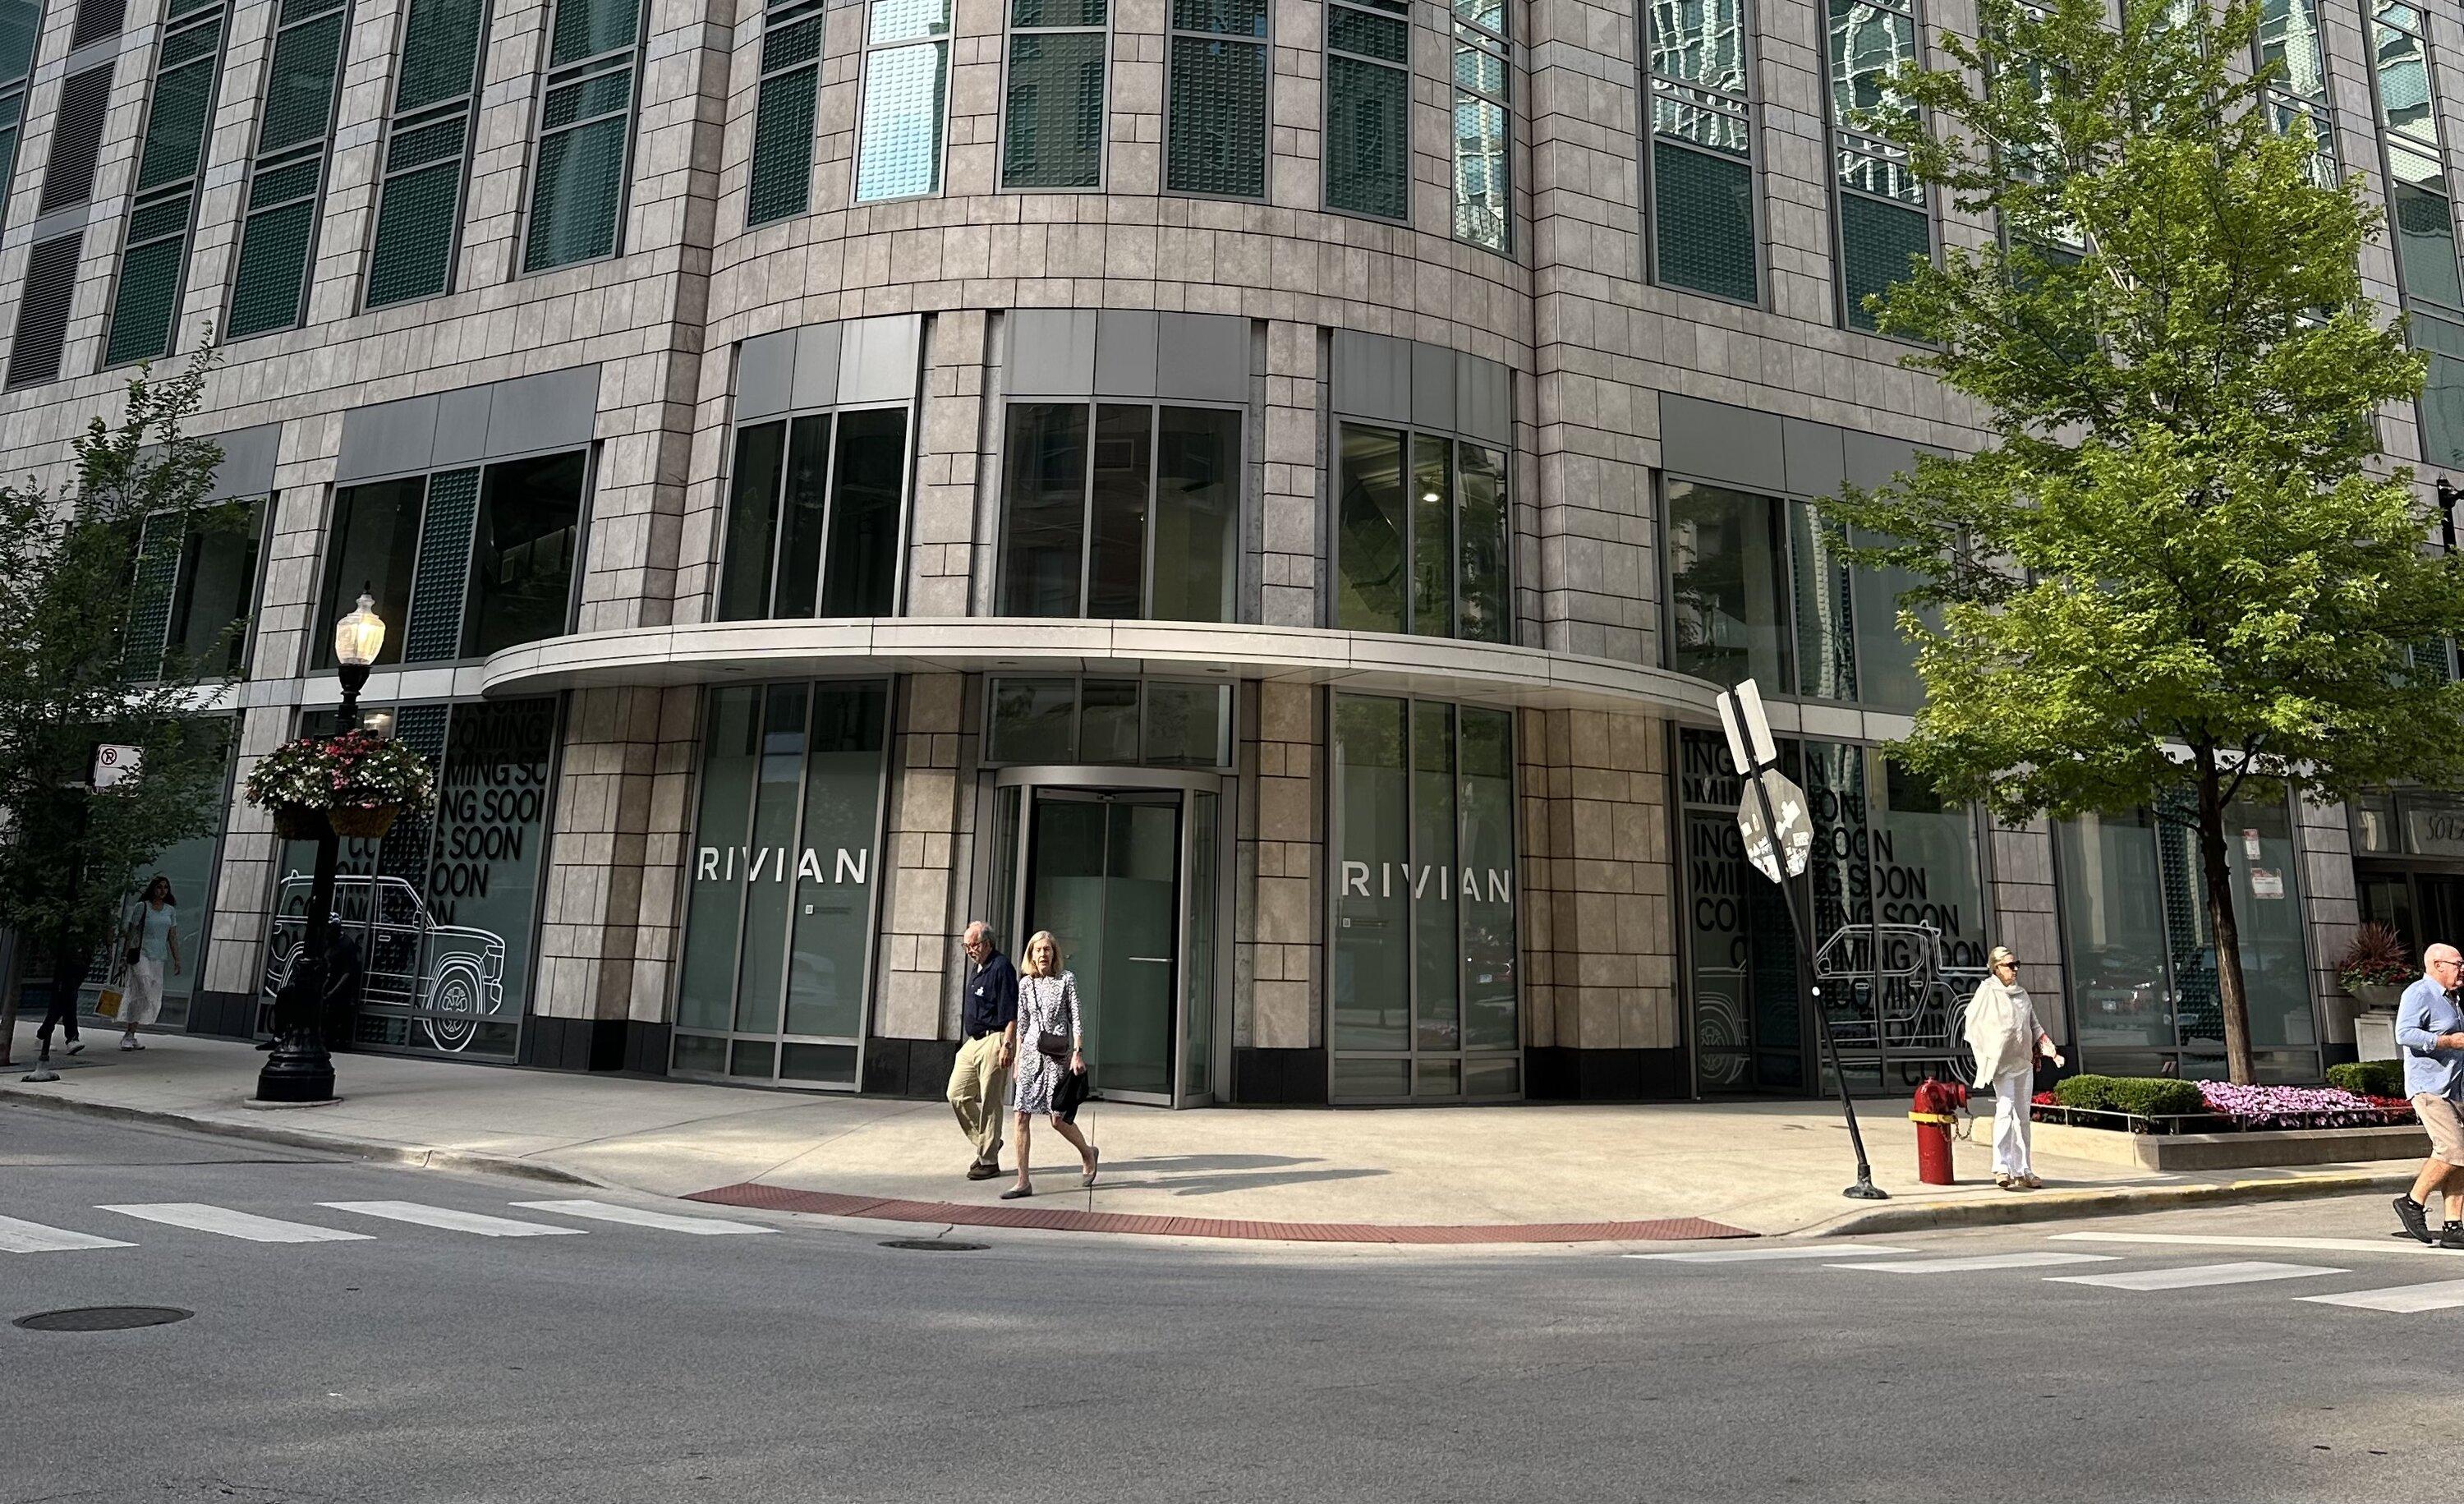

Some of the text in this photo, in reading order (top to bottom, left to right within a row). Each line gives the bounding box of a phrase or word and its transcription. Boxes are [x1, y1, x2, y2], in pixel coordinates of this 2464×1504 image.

[448, 826, 522, 861] SOON
[431, 862, 490, 898] OON
[698, 846, 867, 884] RIVIAN
[1342, 861, 1510, 903] RIVIAN
